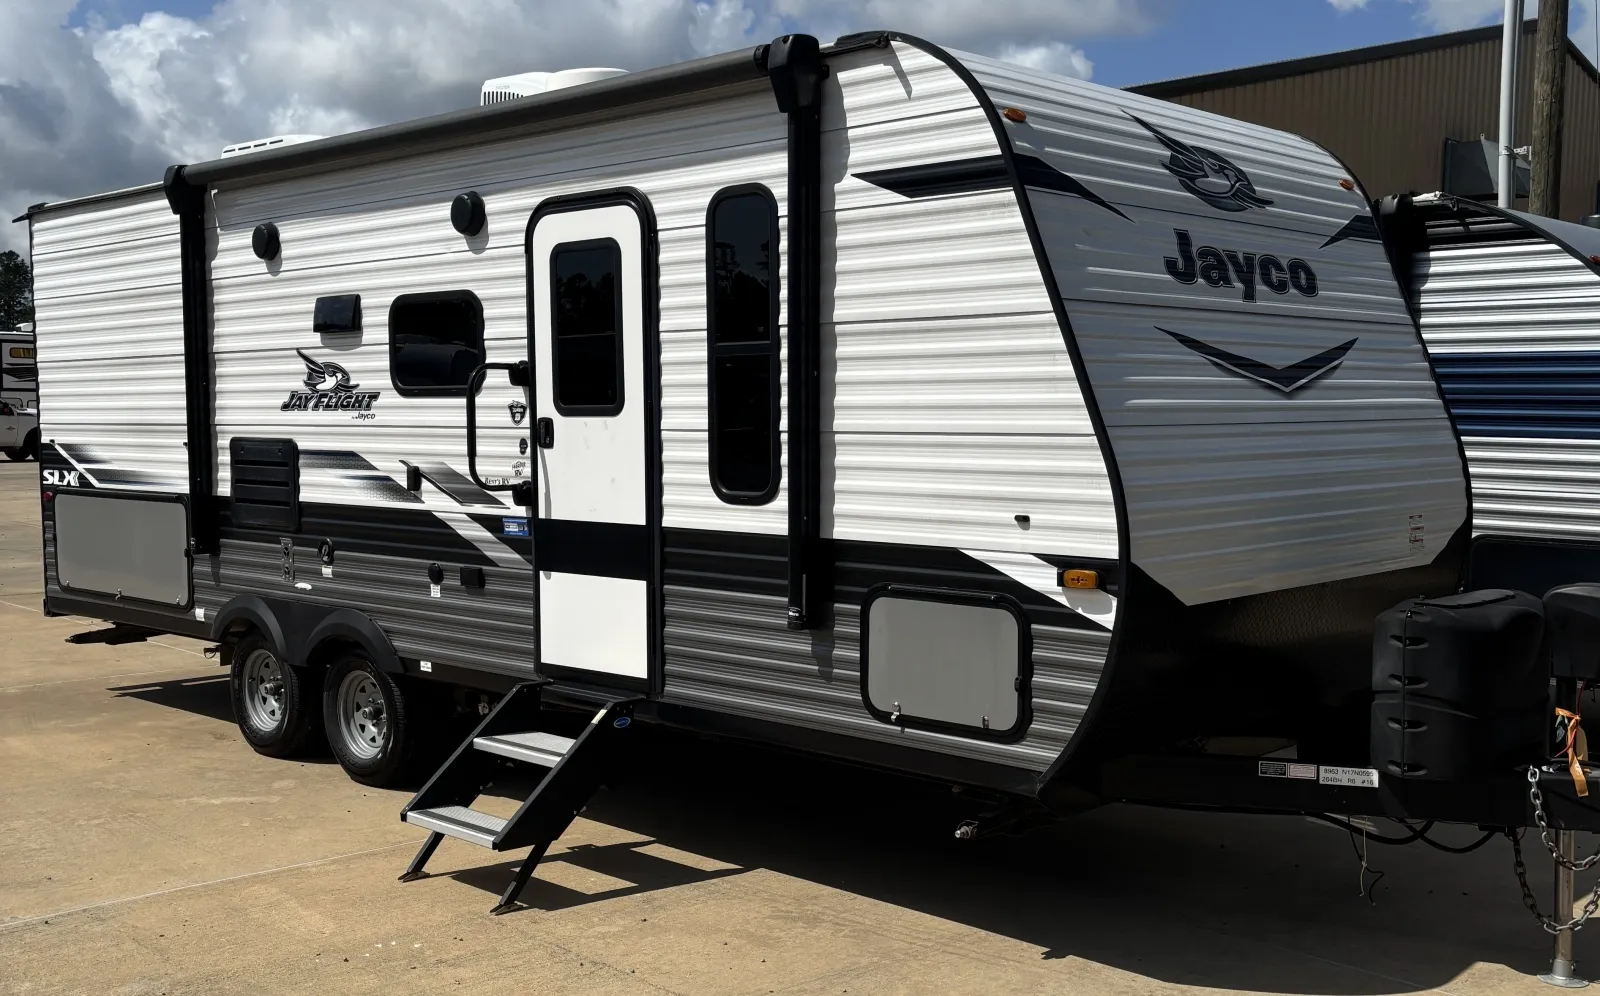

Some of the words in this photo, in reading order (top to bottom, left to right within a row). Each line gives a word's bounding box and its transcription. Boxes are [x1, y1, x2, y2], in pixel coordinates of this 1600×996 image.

[1163, 228, 1319, 303] Jayco
[280, 391, 317, 411] JAY
[312, 391, 381, 411] FLIGHT
[357, 411, 376, 421] Jayco
[42, 469, 80, 487] SLX
